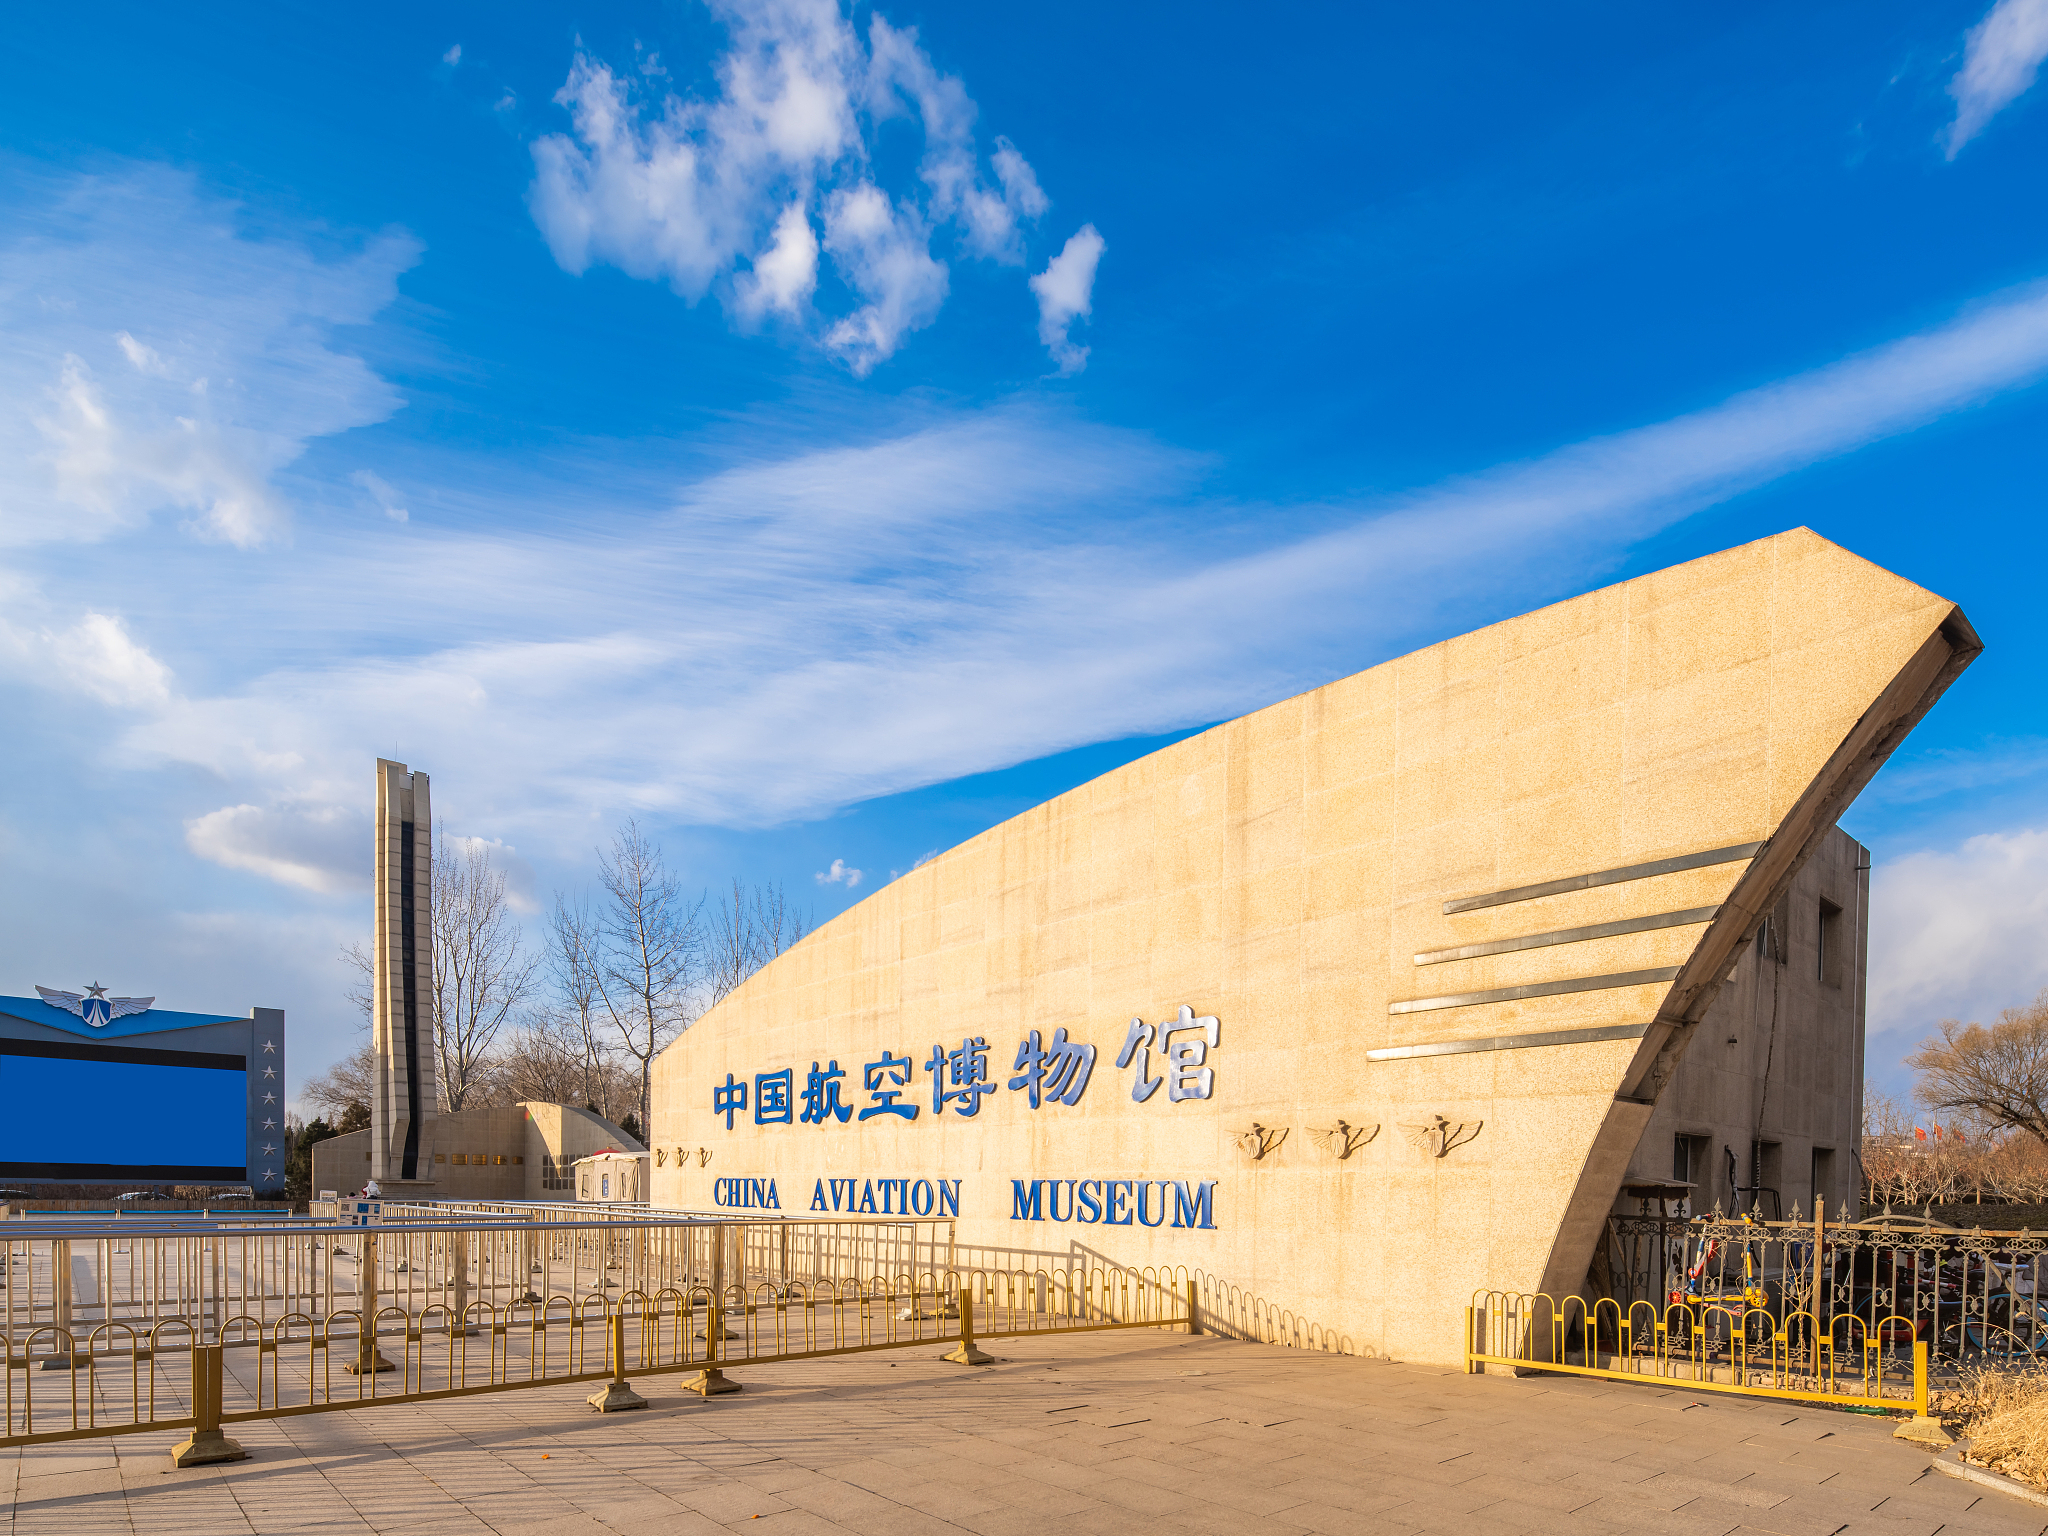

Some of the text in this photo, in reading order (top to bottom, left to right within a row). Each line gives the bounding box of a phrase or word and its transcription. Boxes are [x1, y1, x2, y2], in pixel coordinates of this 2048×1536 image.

[713, 1004, 1221, 1130] 中国航空博物馆
[714, 1177, 1218, 1229] CHINA AVIATION MUSEUM
